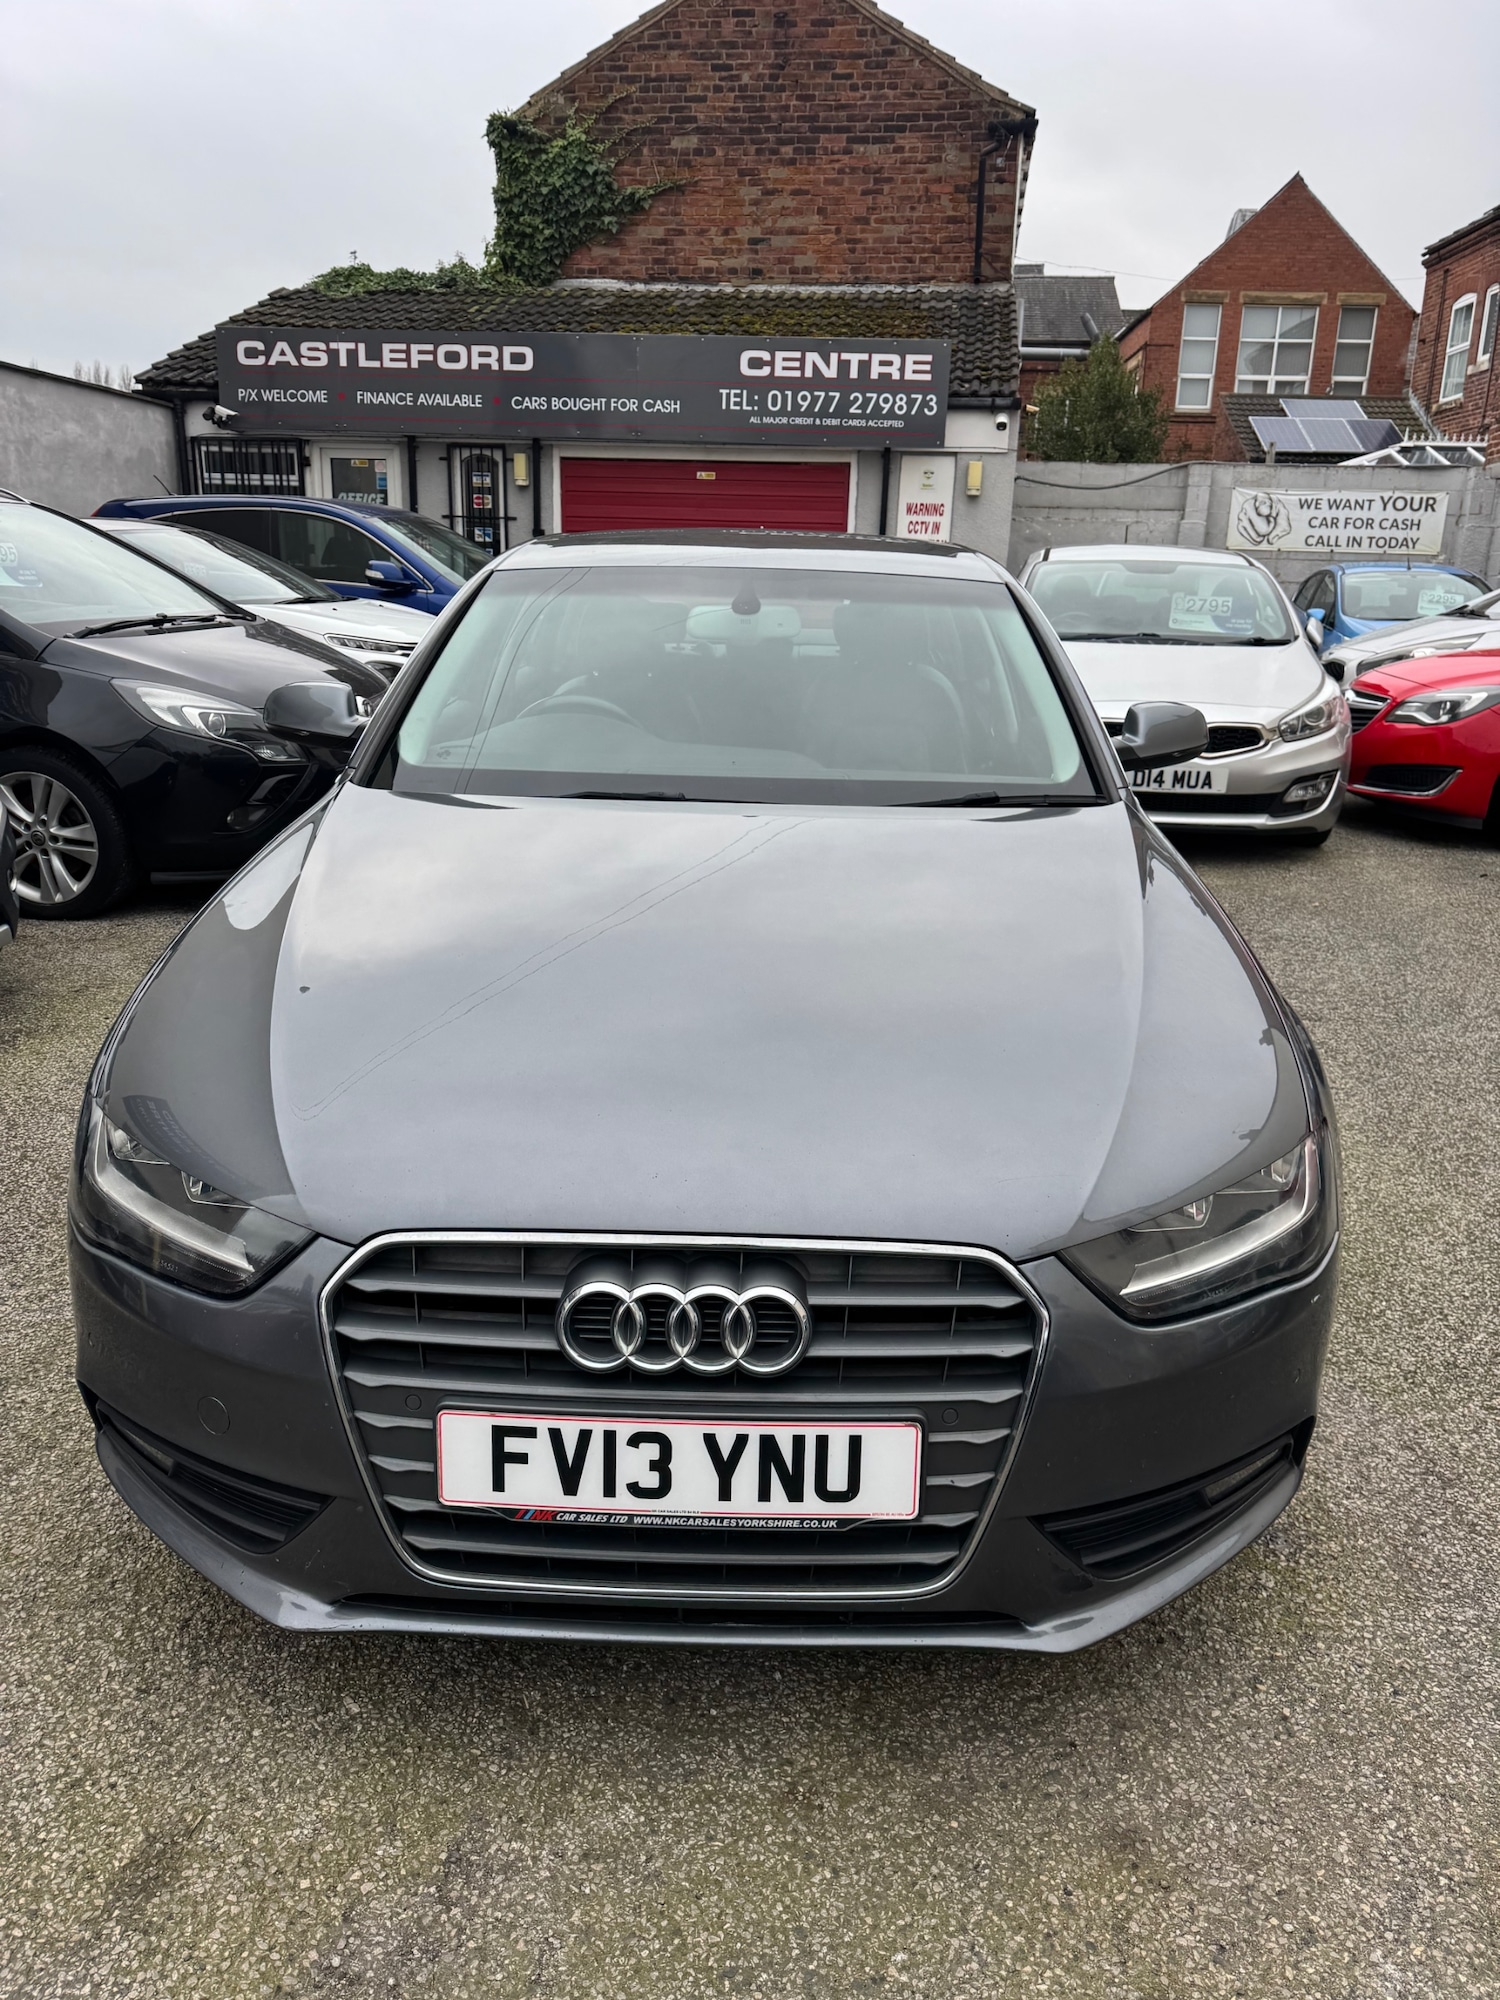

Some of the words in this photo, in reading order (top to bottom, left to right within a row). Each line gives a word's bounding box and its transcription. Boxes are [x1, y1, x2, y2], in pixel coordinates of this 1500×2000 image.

[236, 340, 534, 371] CASTLEFORD
[739, 349, 933, 381] CENTRE
[238, 388, 259, 402] P/X
[260, 389, 328, 403] WELCOME
[357, 391, 414, 406] FINANCE
[417, 393, 483, 407] AVAILABLE
[719, 389, 759, 411] TEL:
[767, 390, 841, 413] 01977
[849, 392, 938, 416] 279873
[511, 396, 548, 410] CARS
[551, 397, 607, 412] BOUGHT
[611, 398, 638, 412] FOR
[642, 399, 681, 413] CASH
[750, 416, 761, 424] ALL
[763, 416, 788, 425] MAJOR
[789, 417, 813, 425] CREDIT
[815, 417, 821, 425] &
[822, 417, 841, 426] DEBIT
[842, 418, 867, 427] CARDS
[868, 419, 904, 428] ACCEPTED
[906, 502, 945, 517] WARNING
[1299, 498, 1323, 510] WE
[1327, 498, 1375, 511] WANT
[1380, 495, 1437, 512] YOUR
[907, 520, 930, 535] CCTV
[931, 521, 941, 535] IN
[1308, 517, 1339, 529] CAR
[1344, 517, 1374, 530] FOR
[1379, 518, 1421, 531] CASH
[1305, 535, 1342, 548] CALL
[1346, 536, 1362, 548] IN
[1366, 536, 1420, 549] TODAY
[1132, 770, 1164, 788] D14
[1172, 770, 1212, 789] MUA
[491, 1425, 673, 1499] FV13
[703, 1433, 862, 1503] YNU
[531, 1510, 557, 1521] NK
[556, 1512, 578, 1522] CAR
[578, 1513, 608, 1523] SALES
[609, 1514, 629, 1524] LTD
[633, 1516, 839, 1528] WWW.NKCARSALESYORKSHIRE.CO.UK
